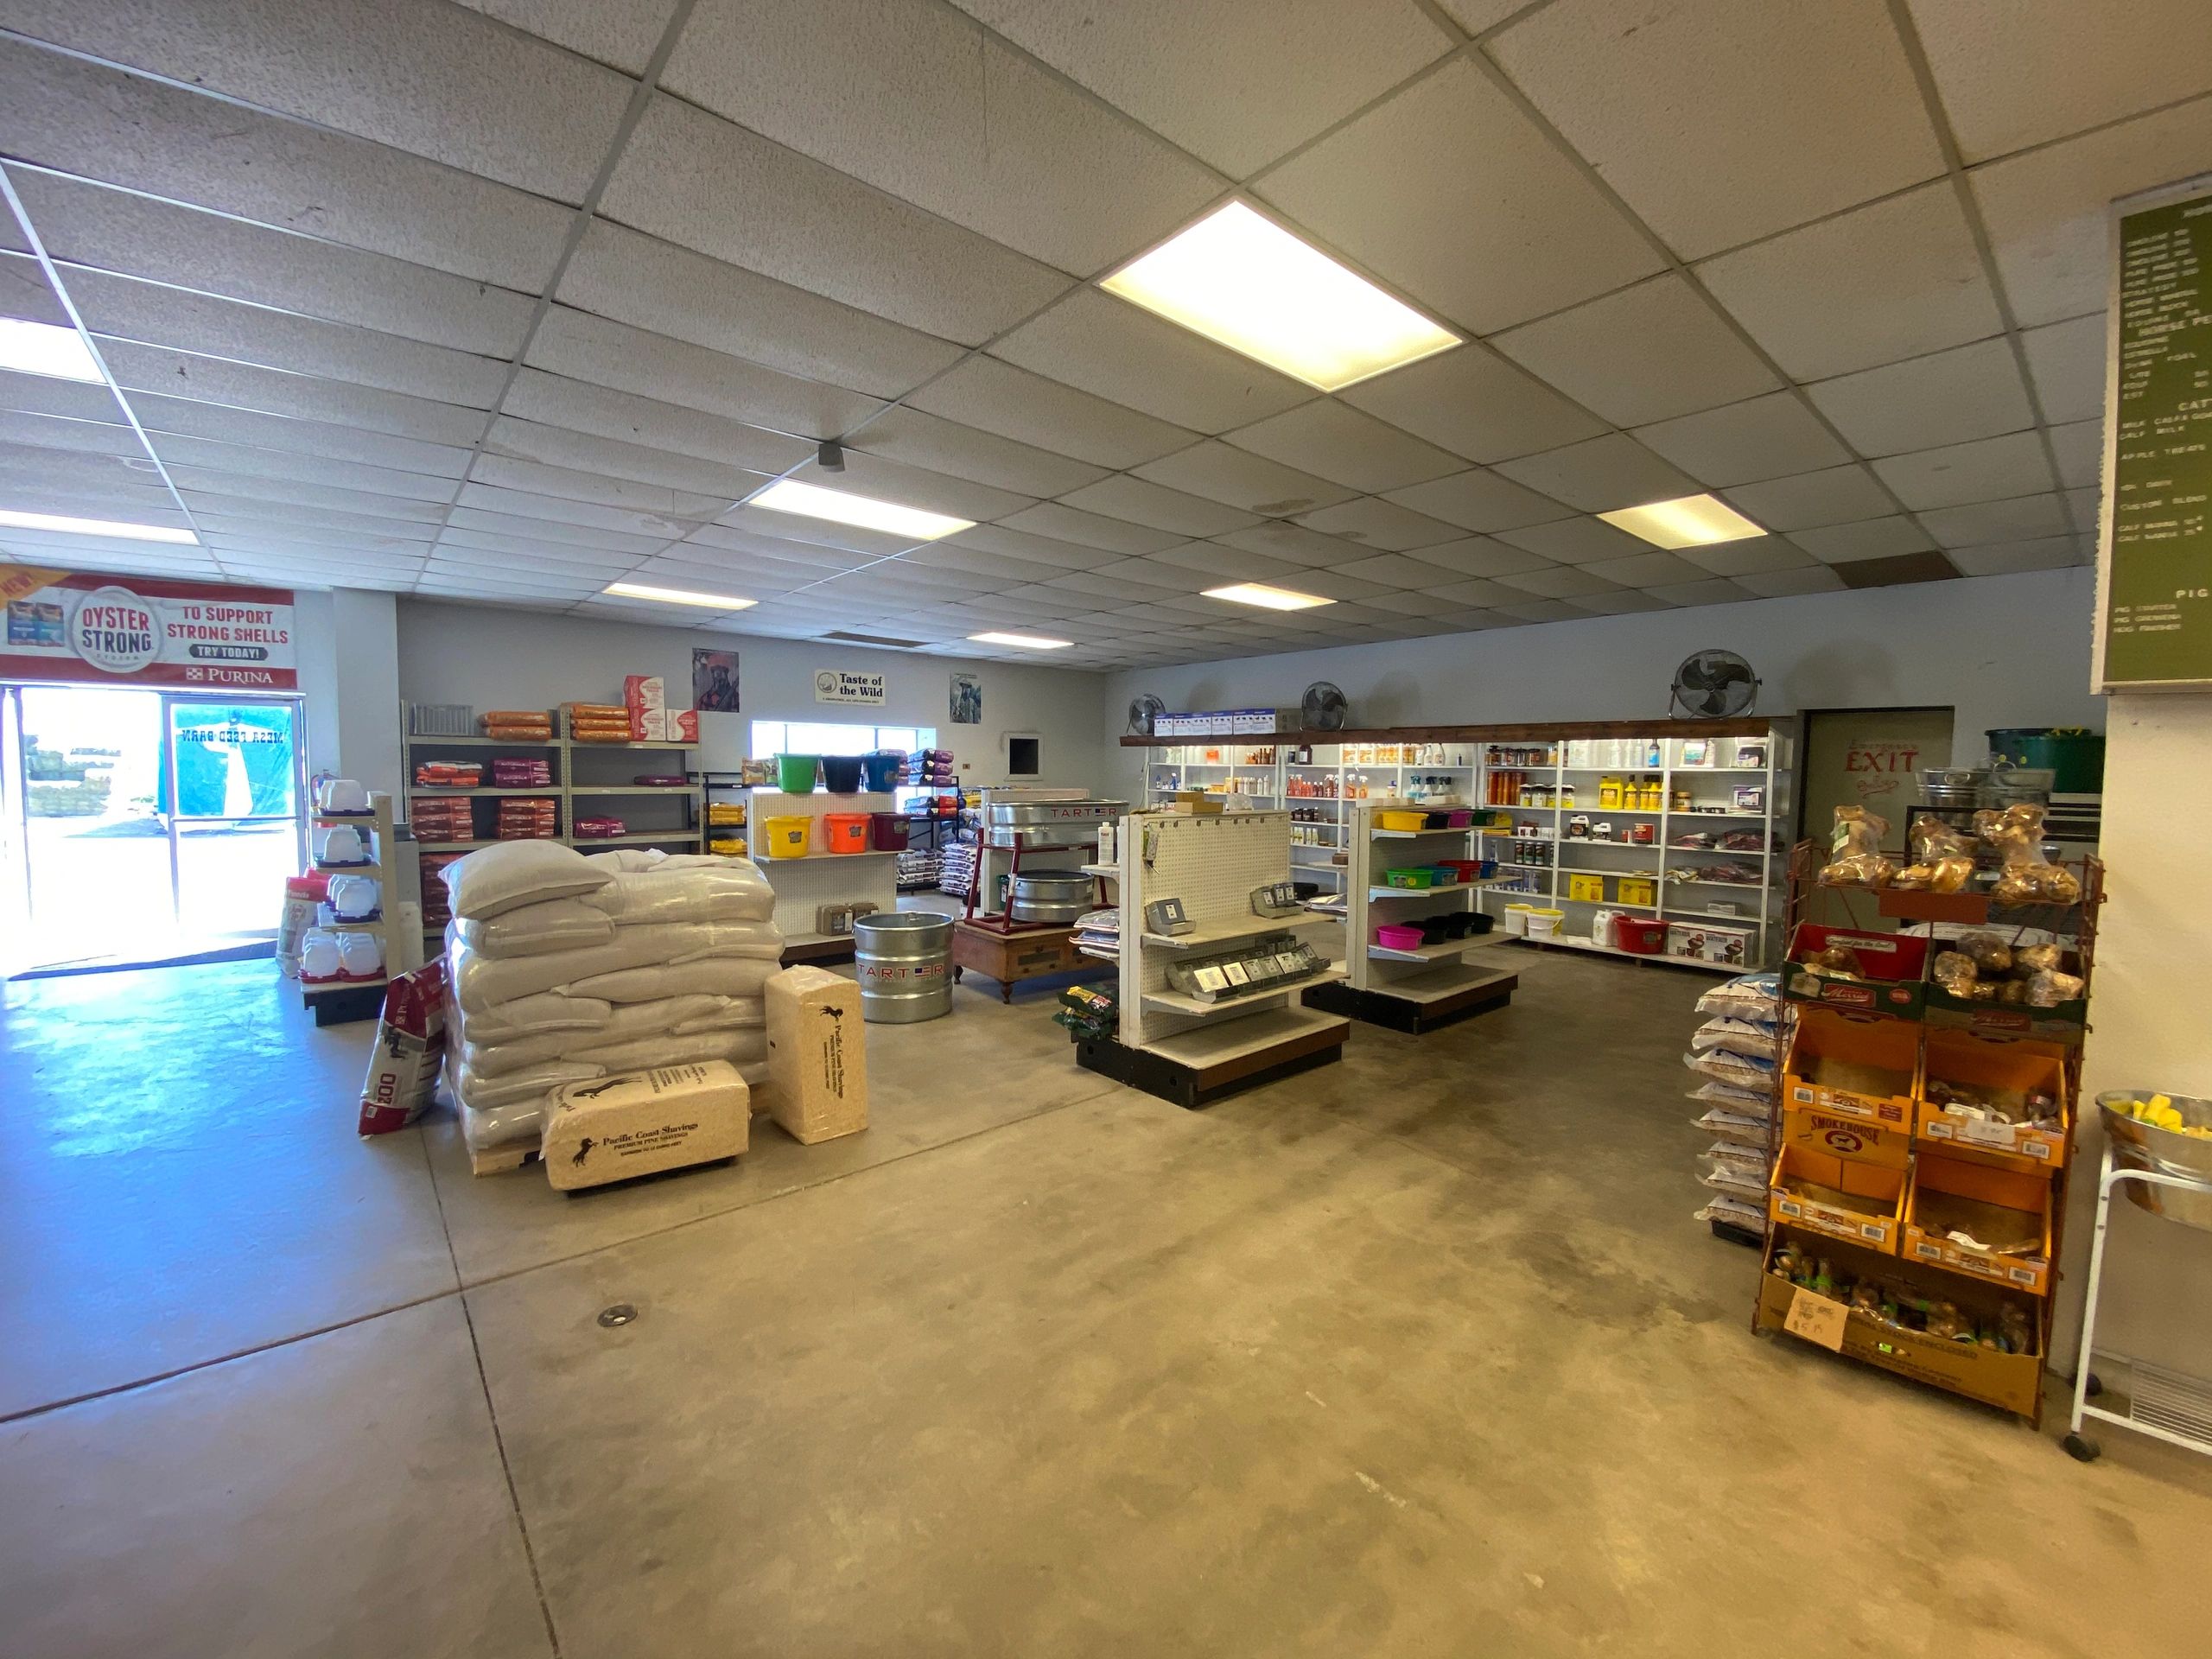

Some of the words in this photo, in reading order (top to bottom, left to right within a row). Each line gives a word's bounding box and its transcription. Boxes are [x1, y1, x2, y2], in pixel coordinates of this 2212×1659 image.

[2176, 588, 2209, 599] PIG
[82, 607, 150, 631] OYSTER
[182, 606, 201, 620] TO
[206, 607, 273, 624] SUPPORT
[82, 629, 152, 654] STRONG
[167, 623, 230, 641] STRONG
[234, 628, 289, 644] SHELLS
[197, 645, 219, 657] TRY
[221, 646, 259, 658] TODAY!
[207, 668, 274, 683] PURINA
[839, 673, 868, 684] Taste
[871, 676, 882, 686] of
[839, 685, 856, 696] the
[860, 686, 883, 697] Wild
[1845, 750, 1919, 772] EXIT
[1051, 807, 1117, 817] TARTER
[858, 963, 944, 979] TARTER
[602, 1134, 632, 1146] Pacific
[635, 1128, 659, 1139] Coast
[661, 1122, 699, 1134] Shavings
[1810, 1115, 1880, 1147] SMOKEHOUSE
[613, 1140, 643, 1150] PREMIUM
